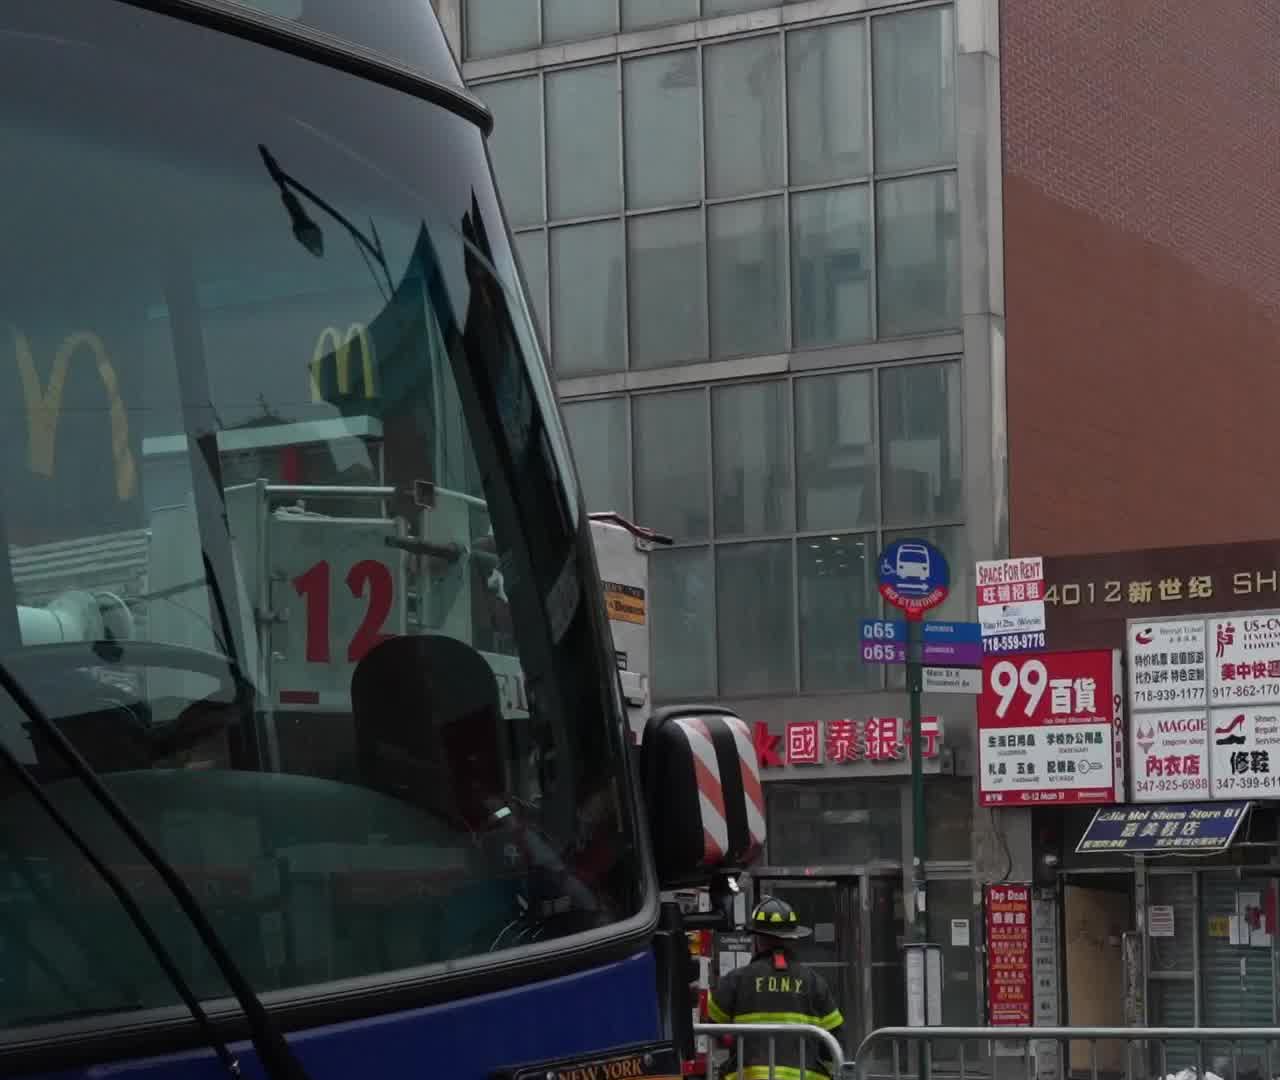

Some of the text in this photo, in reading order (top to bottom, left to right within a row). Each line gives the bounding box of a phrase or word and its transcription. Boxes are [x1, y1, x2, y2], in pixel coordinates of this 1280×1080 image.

[979, 561, 1041, 584] SPACE FOR RENT
[1044, 575, 1214, 605] 4012 新世纪
[982, 632, 1046, 652] 718-559-9778
[990, 659, 1048, 718] 99
[1135, 688, 1205, 702] 718-939-1177
[1157, 719, 1208, 733] MAGGIE
[1230, 750, 1269, 774] 修鞋
[1136, 778, 1208, 792] 347-925-6988
[602, 1058, 642, 1080] YORK
